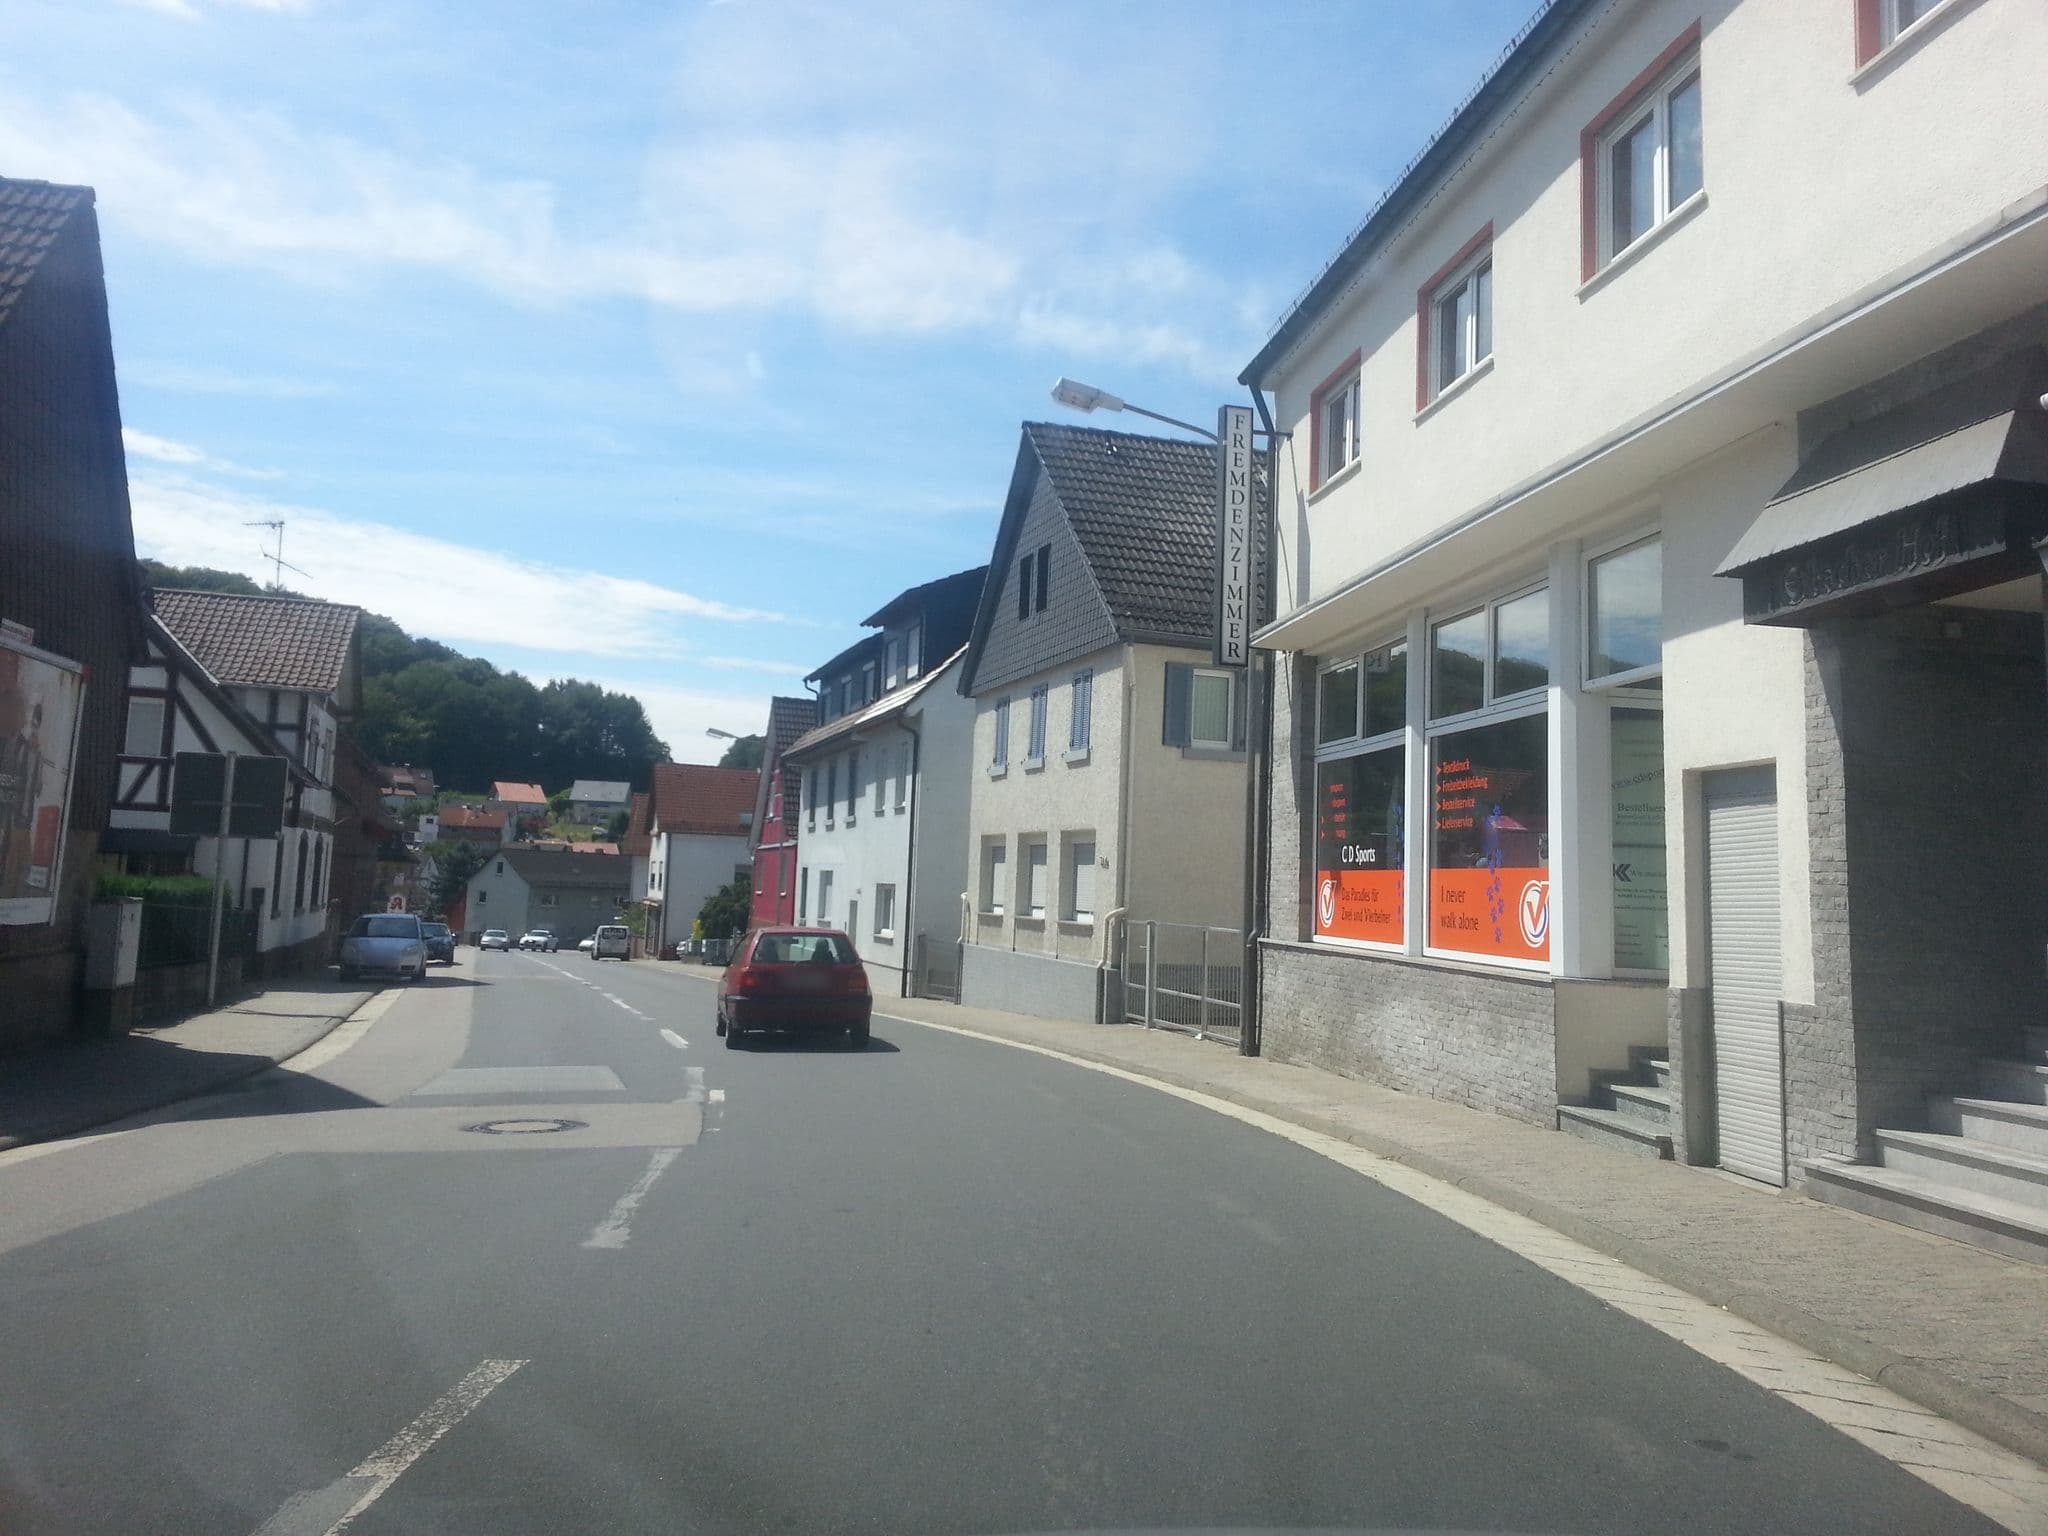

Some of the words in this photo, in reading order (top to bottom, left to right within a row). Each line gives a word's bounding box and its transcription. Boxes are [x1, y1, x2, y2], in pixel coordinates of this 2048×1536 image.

[1227, 414, 1246, 658] FREMDENZIMMER
[1341, 845, 1348, 863] C
[1348, 845, 1354, 863] D
[1355, 844, 1376, 866] Sports
[1446, 889, 1466, 904] never
[1440, 912, 1457, 929] walk
[1459, 912, 1479, 931] alone
